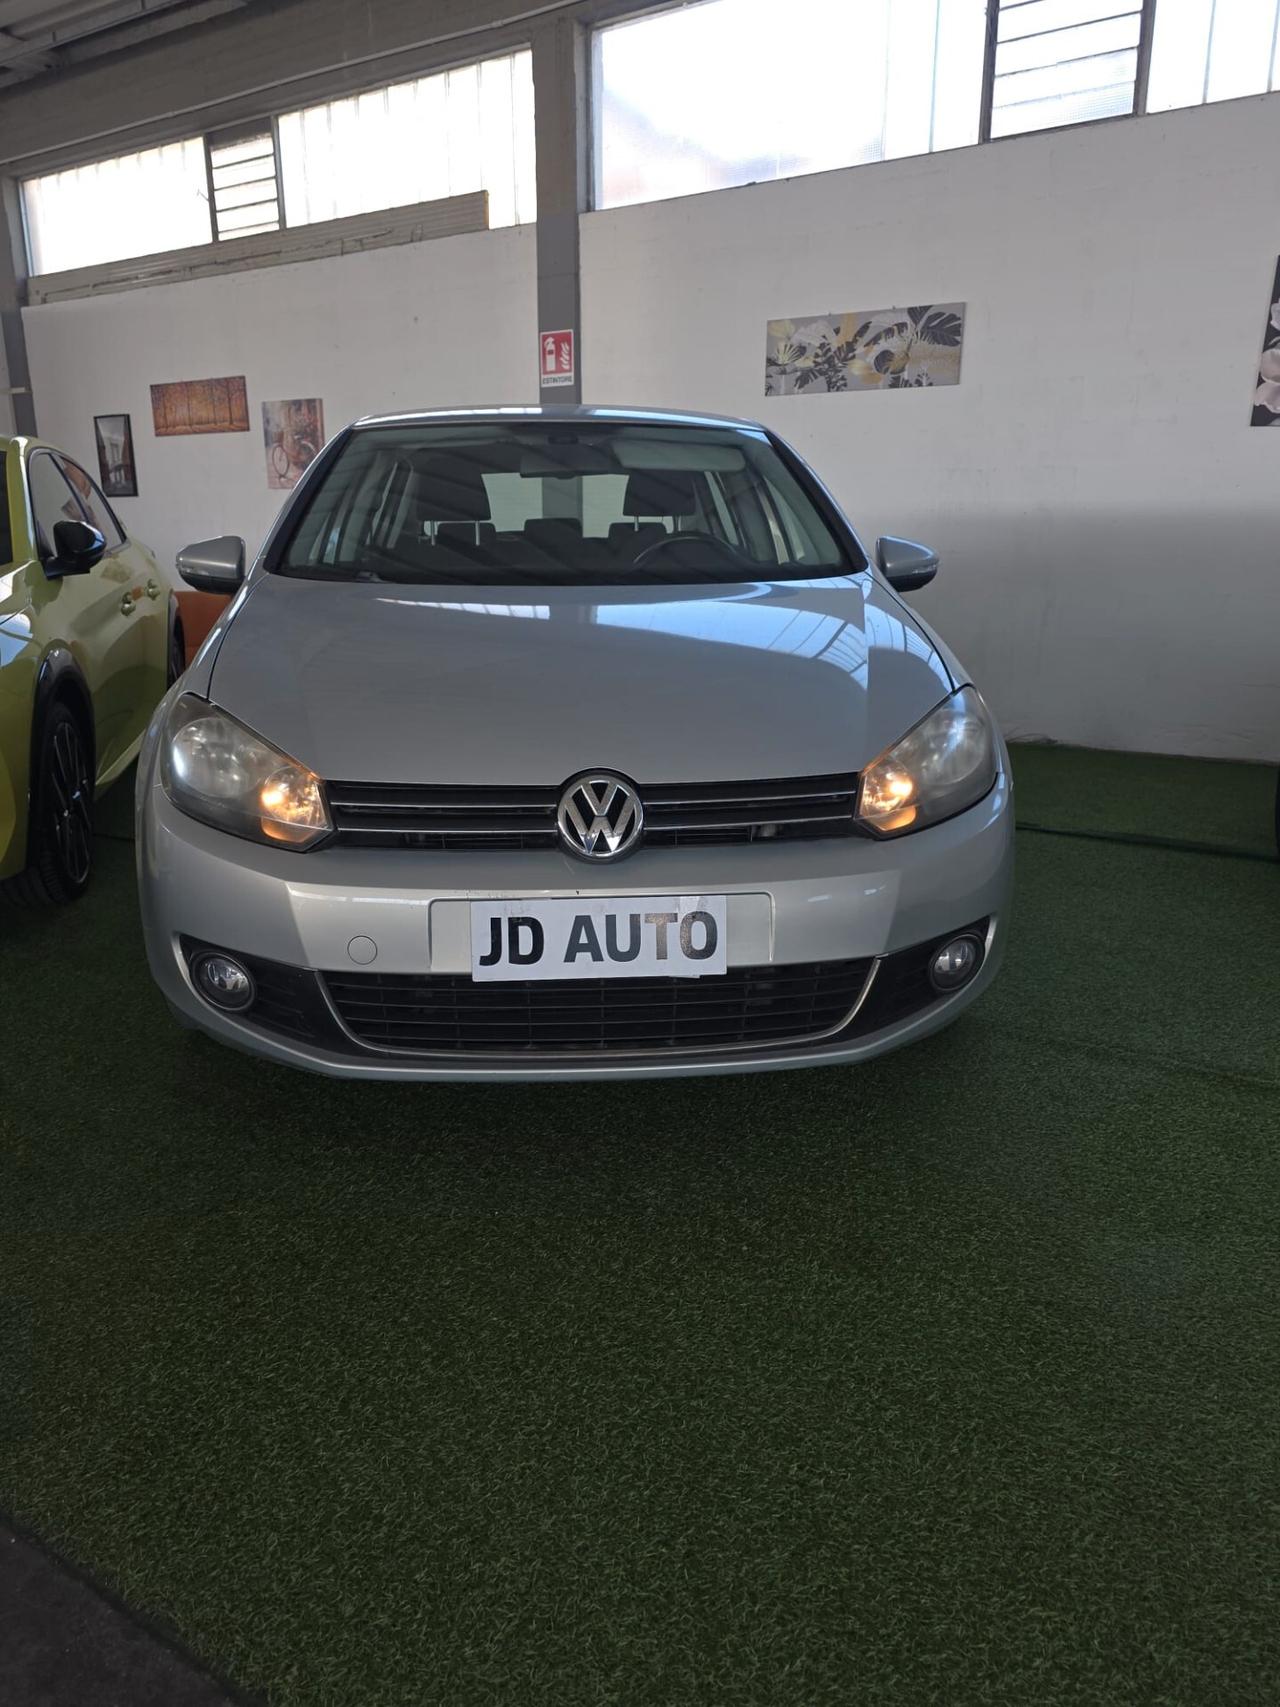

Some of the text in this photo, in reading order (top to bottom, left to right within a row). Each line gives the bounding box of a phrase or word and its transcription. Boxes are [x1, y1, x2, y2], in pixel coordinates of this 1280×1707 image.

[559, 774, 642, 857] VW
[479, 911, 718, 967] JD AUTO
